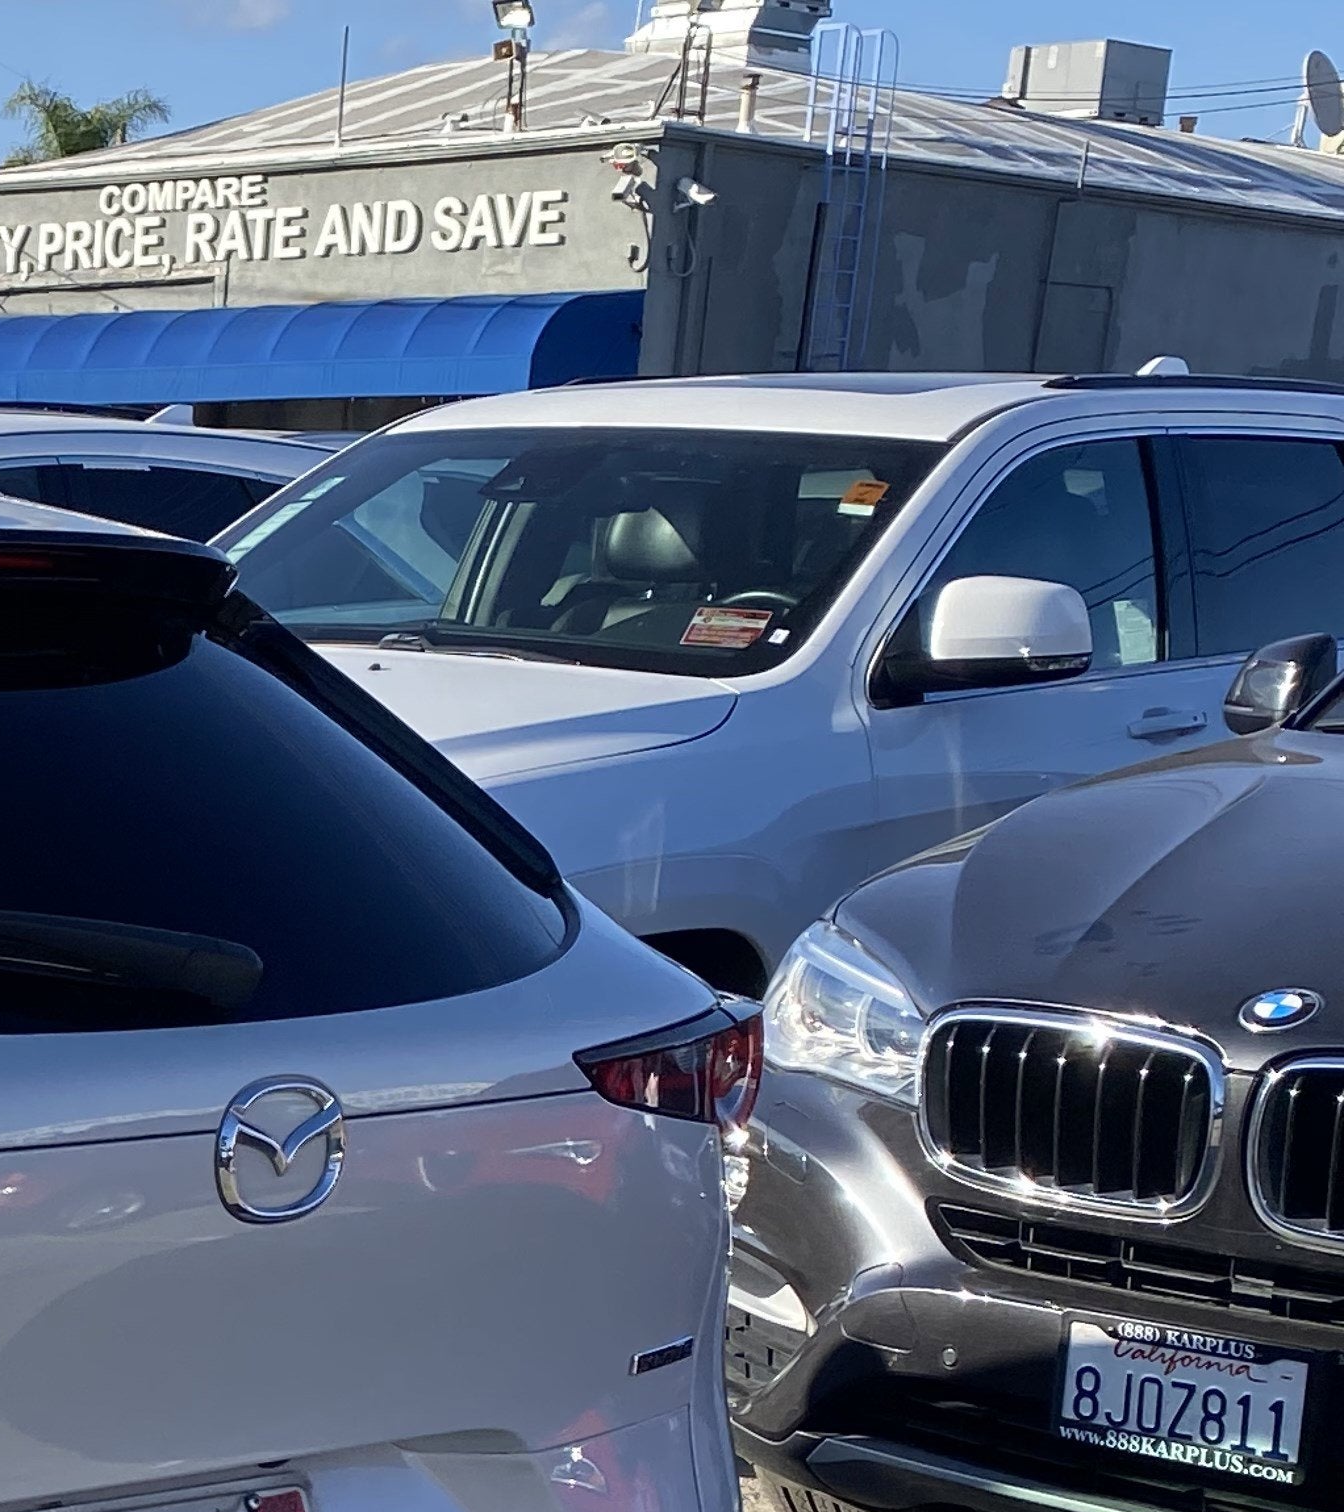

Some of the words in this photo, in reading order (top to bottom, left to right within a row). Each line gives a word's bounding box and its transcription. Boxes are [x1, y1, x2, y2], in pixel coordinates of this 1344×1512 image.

[99, 174, 267, 215] COMPARE
[184, 206, 308, 263] RATE
[313, 199, 422, 258] AND
[430, 190, 570, 253] SAVE
[1113, 1339, 1268, 1383] California
[1117, 1321, 1161, 1342] (888)
[1165, 1331, 1256, 1360] KARPLUS
